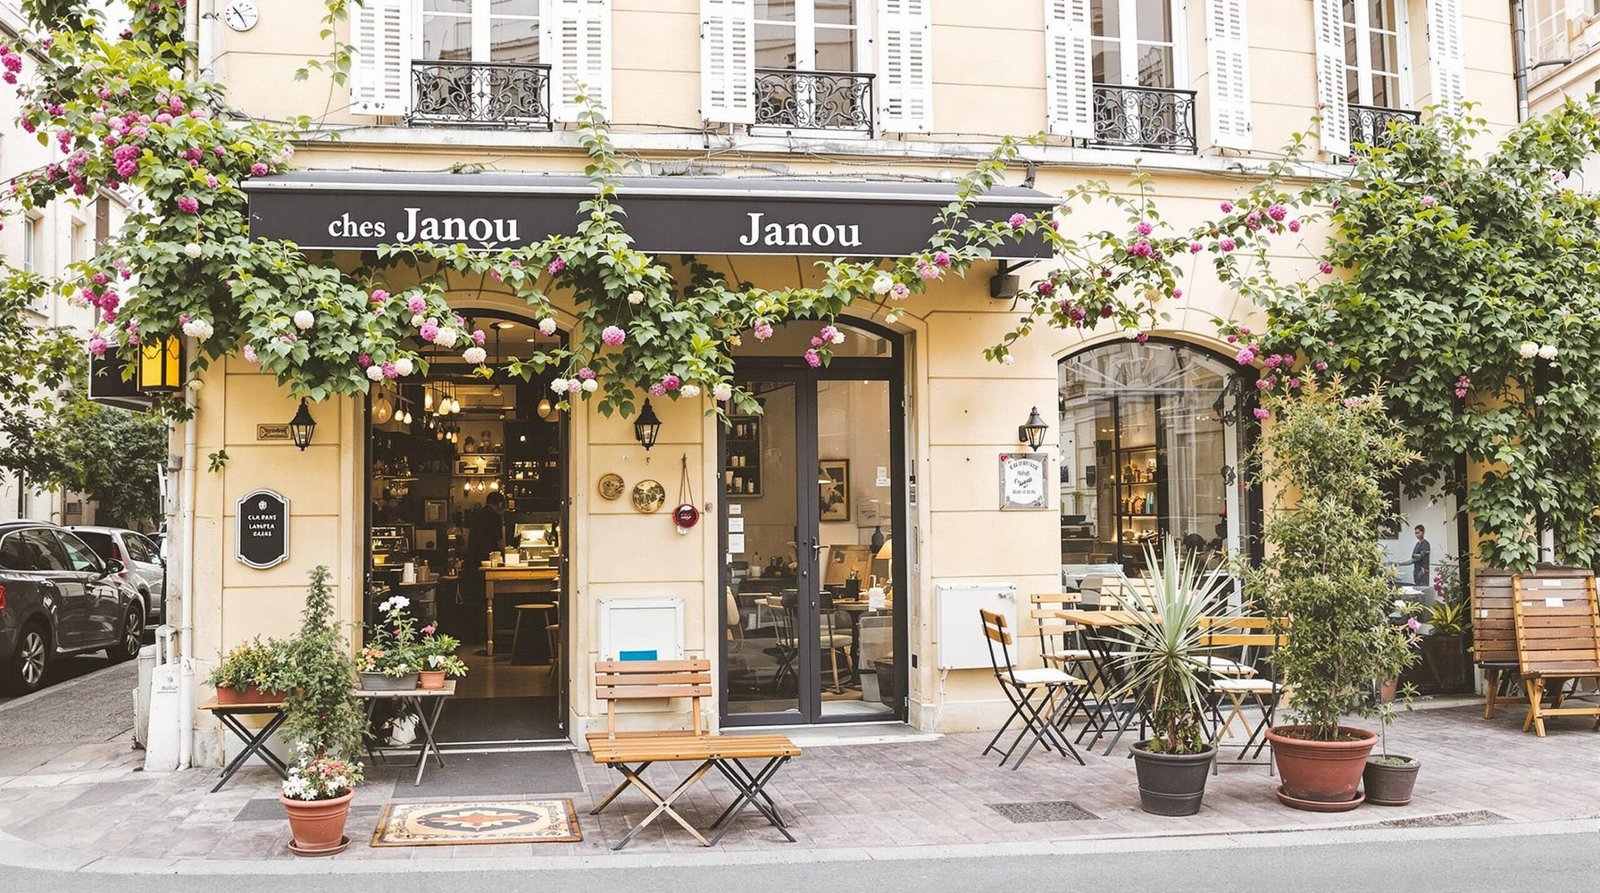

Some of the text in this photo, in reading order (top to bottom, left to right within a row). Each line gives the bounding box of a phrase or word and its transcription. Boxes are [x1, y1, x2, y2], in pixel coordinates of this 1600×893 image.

[328, 207, 521, 242] ches Janou
[739, 212, 863, 247] Janou
